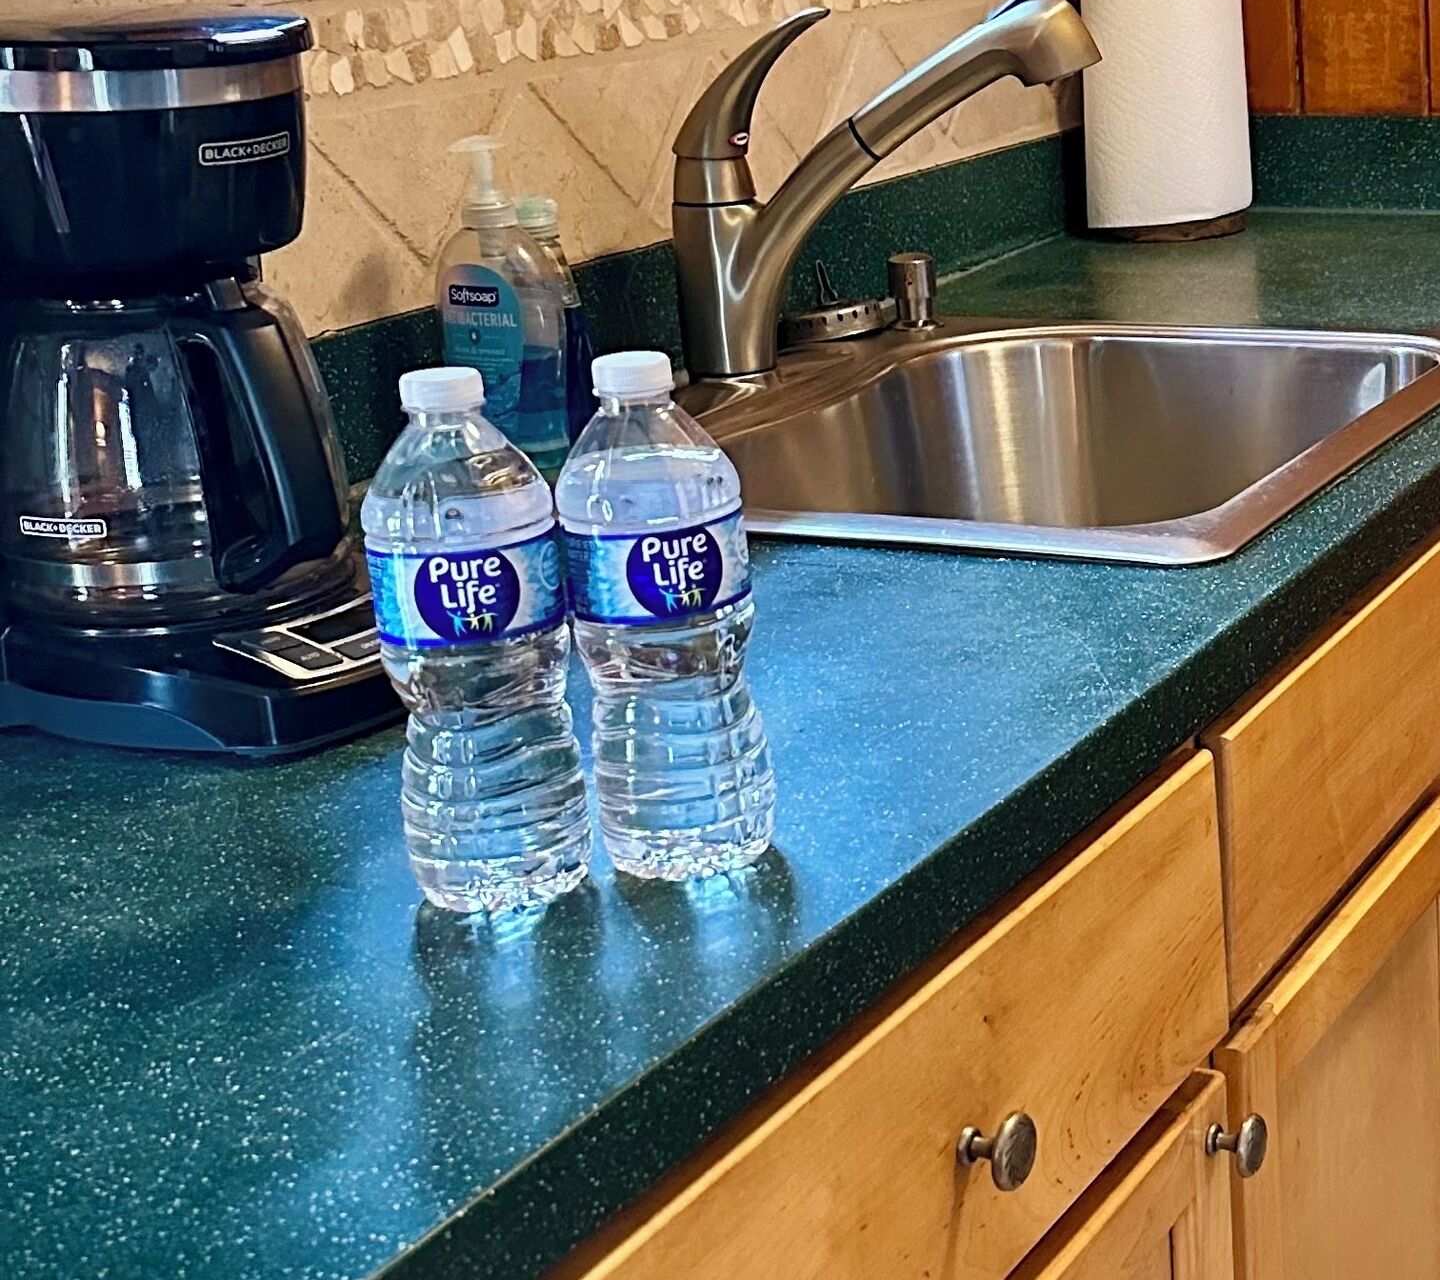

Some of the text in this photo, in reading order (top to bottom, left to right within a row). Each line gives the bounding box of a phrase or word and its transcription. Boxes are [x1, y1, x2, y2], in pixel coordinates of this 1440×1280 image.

[204, 136, 287, 160] BLACK+DECKER
[451, 287, 496, 305] Softsoap
[23, 520, 102, 534] BLACK+DECKER
[642, 533, 708, 563] Pure
[428, 556, 502, 584] Pure
[653, 557, 705, 590] Life
[440, 580, 497, 614] Life
